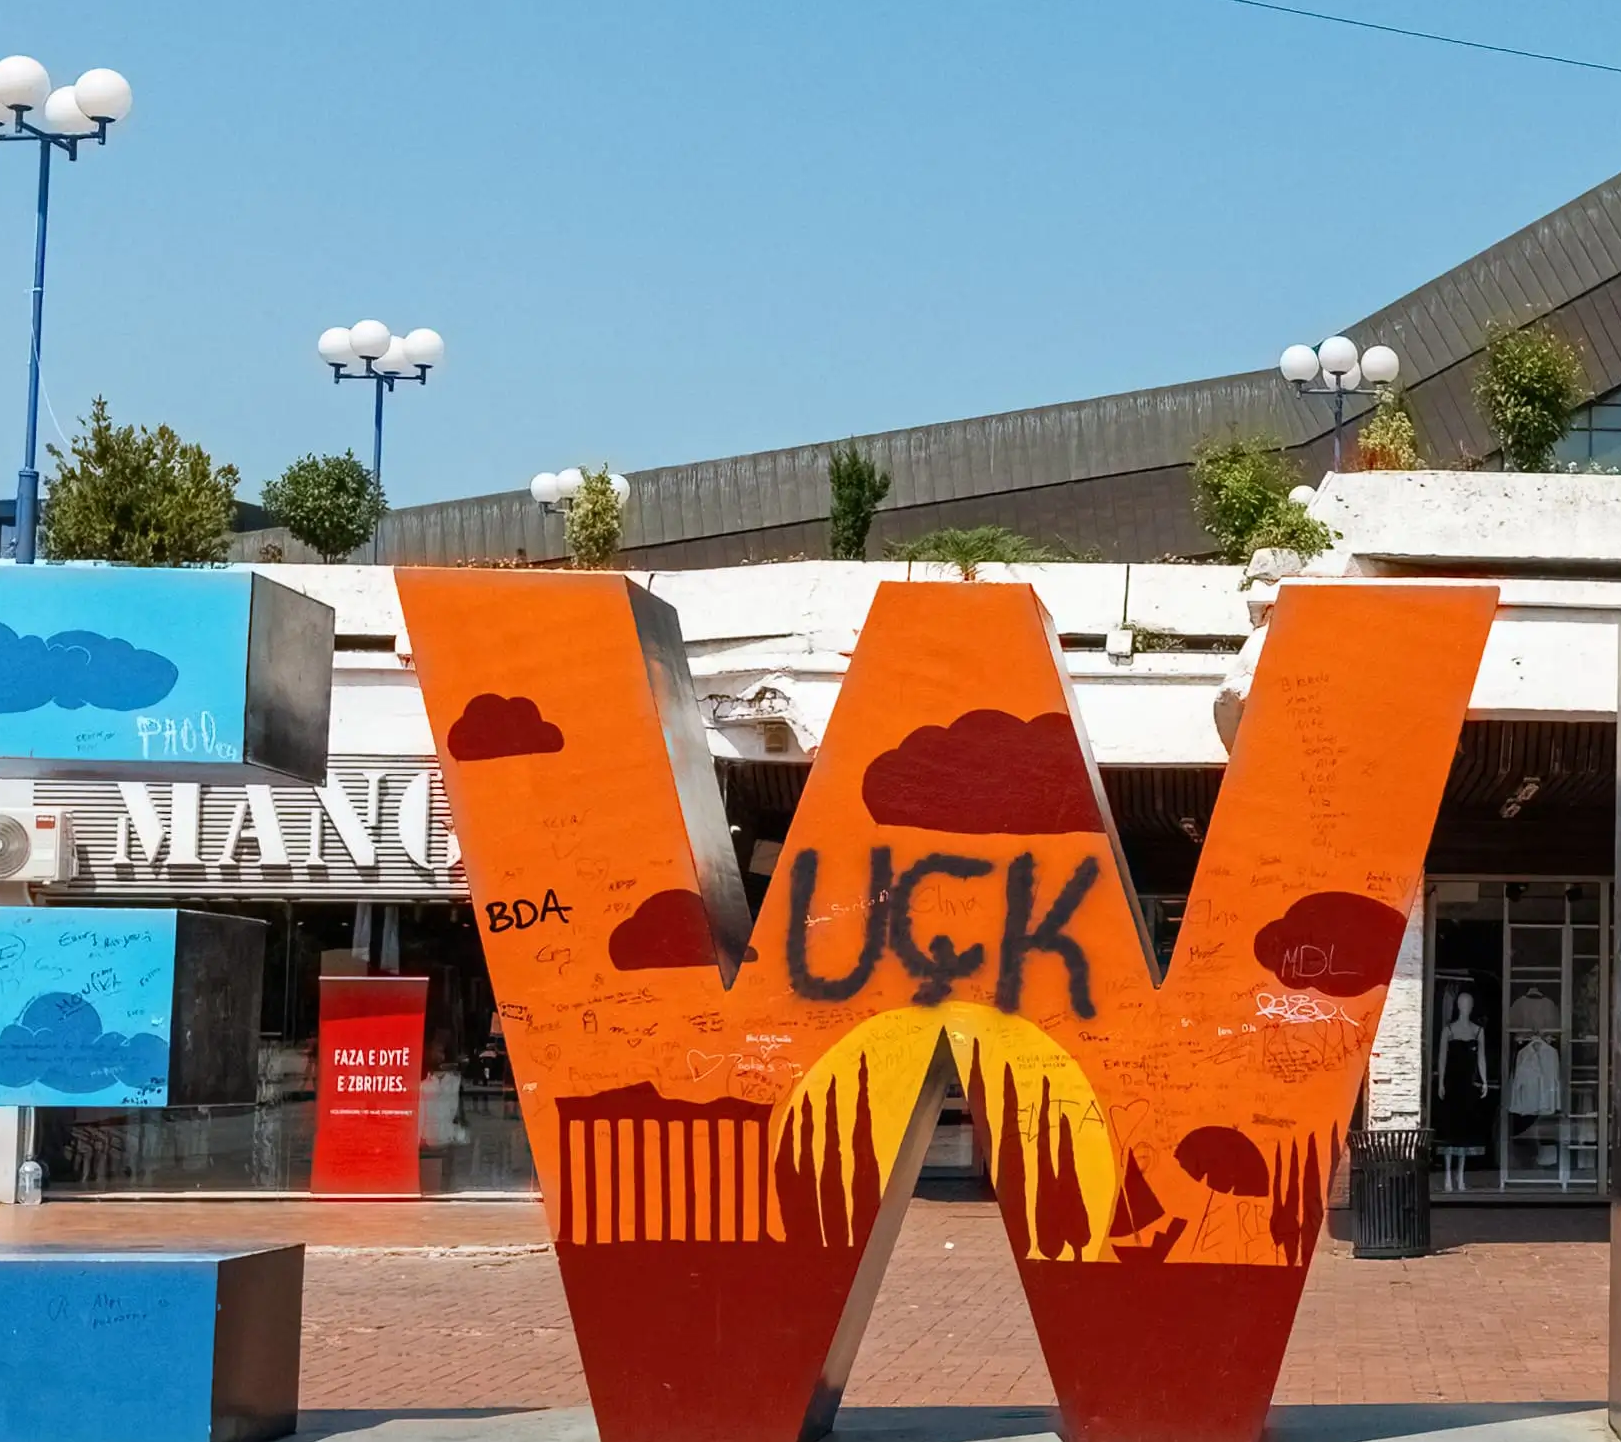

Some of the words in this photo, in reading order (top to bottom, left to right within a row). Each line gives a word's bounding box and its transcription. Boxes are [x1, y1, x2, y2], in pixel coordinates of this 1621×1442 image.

[485, 888, 573, 933] BDA
[1281, 943, 1366, 979] MDL
[334, 1049, 365, 1066] FAZA
[368, 1049, 376, 1066] E
[379, 1047, 410, 1066] DYTË
[337, 1075, 345, 1092] E
[348, 1075, 407, 1092] ZBRITJES.
